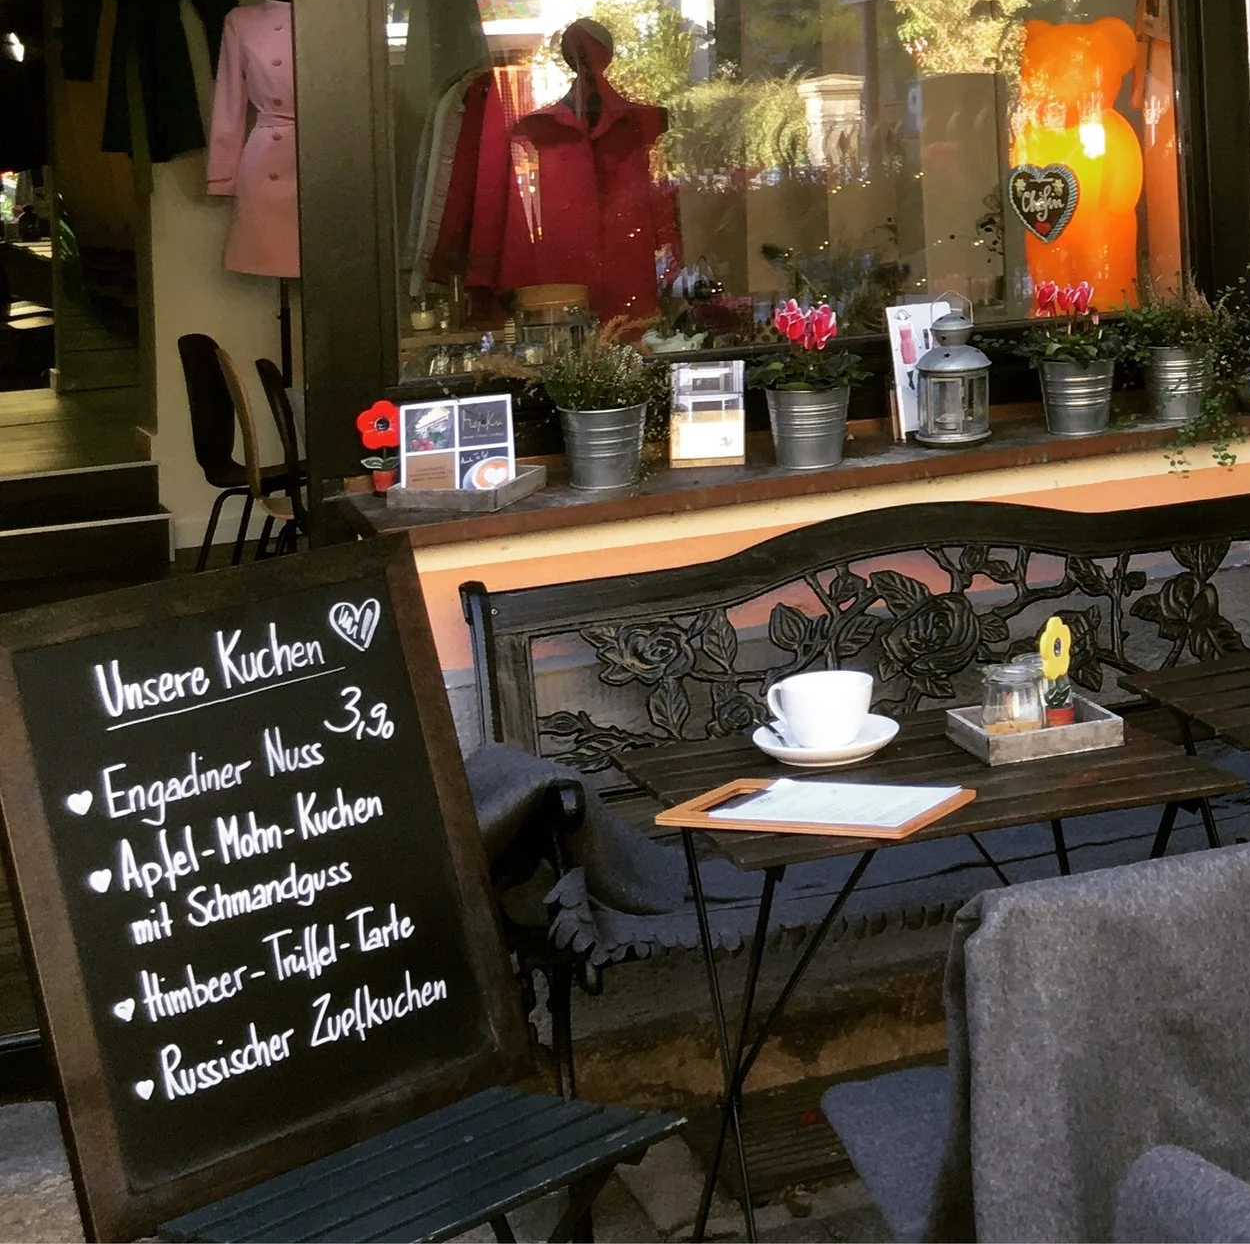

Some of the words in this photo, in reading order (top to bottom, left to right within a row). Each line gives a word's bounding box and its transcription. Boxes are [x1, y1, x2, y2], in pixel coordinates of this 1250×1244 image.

[1021, 184, 1064, 222] Chefin
[93, 659, 210, 718] Unsere
[215, 622, 325, 689] Kuchen
[102, 751, 251, 826] Engadiner
[263, 727, 325, 777] Nuss
[129, 901, 174, 946] mit
[186, 861, 353, 928] Schmandguss
[159, 1022, 295, 1101] Russischer
[310, 969, 448, 1042] Zupfkuchen
